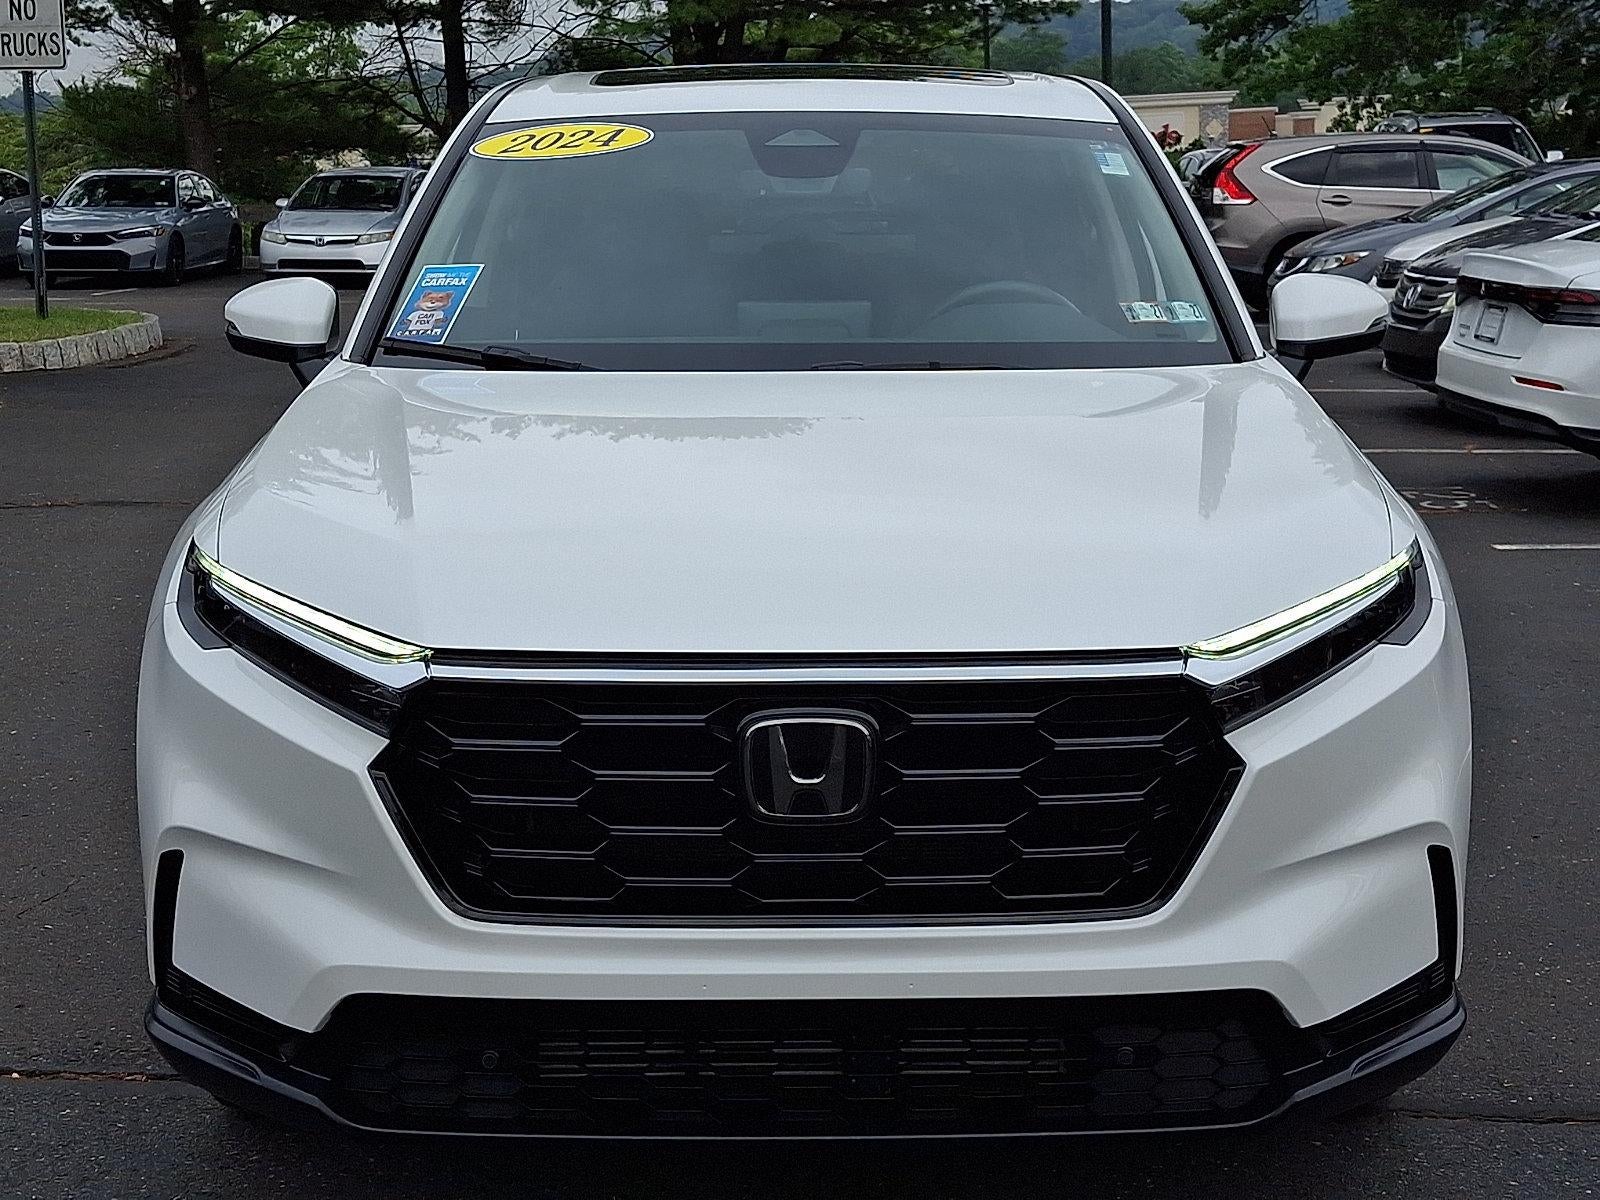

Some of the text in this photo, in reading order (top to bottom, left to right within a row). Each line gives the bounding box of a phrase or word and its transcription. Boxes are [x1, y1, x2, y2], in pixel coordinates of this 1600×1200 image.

[9, 0, 36, 21] NO
[0, 32, 61, 57] RUCKS
[497, 128, 626, 155] 2024
[421, 277, 468, 287] CARFAX
